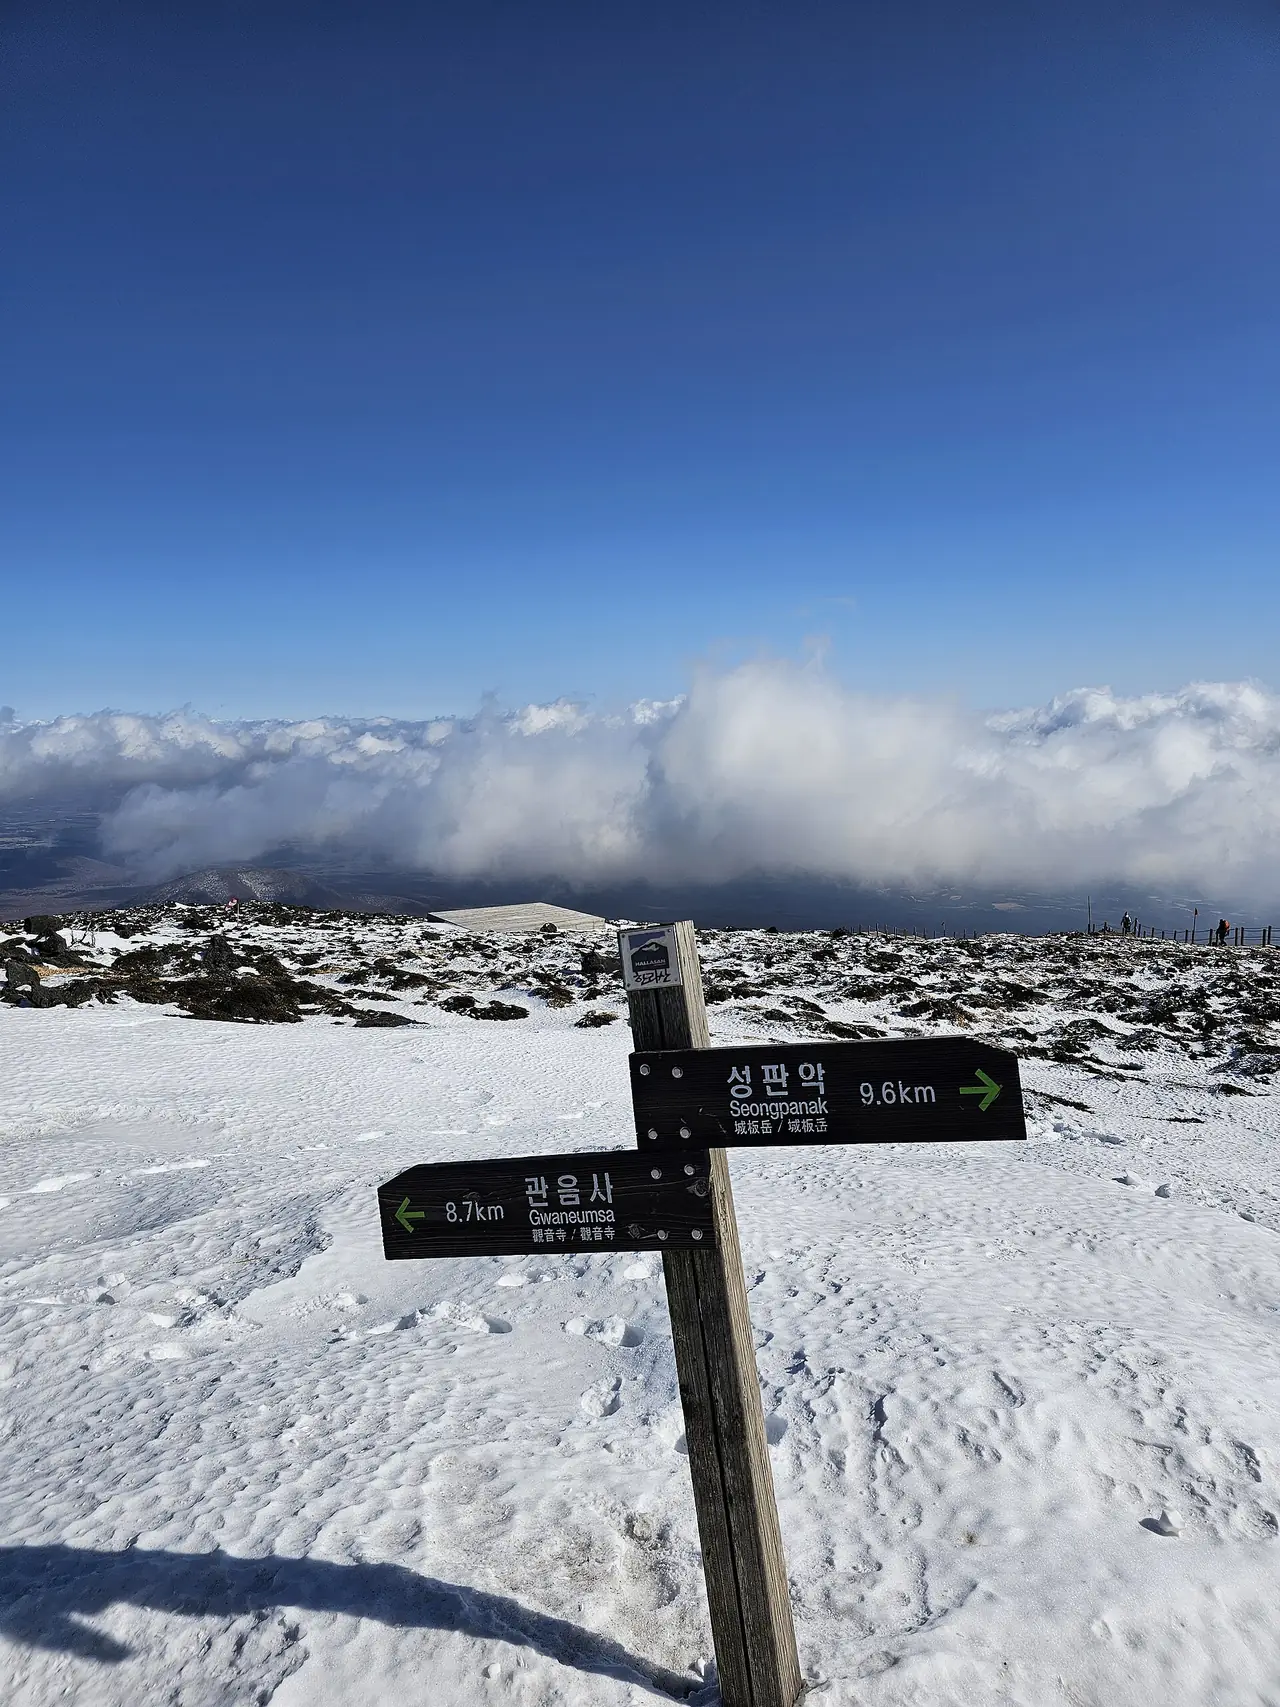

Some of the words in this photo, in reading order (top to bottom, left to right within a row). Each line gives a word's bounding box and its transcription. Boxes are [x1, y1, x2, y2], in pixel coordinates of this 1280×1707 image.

[635, 958, 666, 967] HALLASAN
[633, 968, 671, 986] 한라산
[726, 1062, 826, 1098] 성판악
[859, 1081, 936, 1106] 9.6km
[729, 1098, 829, 1120] Seongpanak
[734, 1119, 773, 1135] 城板岳
[524, 1172, 613, 1207] 관음사
[445, 1201, 505, 1223] 8.7km
[528, 1208, 616, 1226] Gwaneumsa
